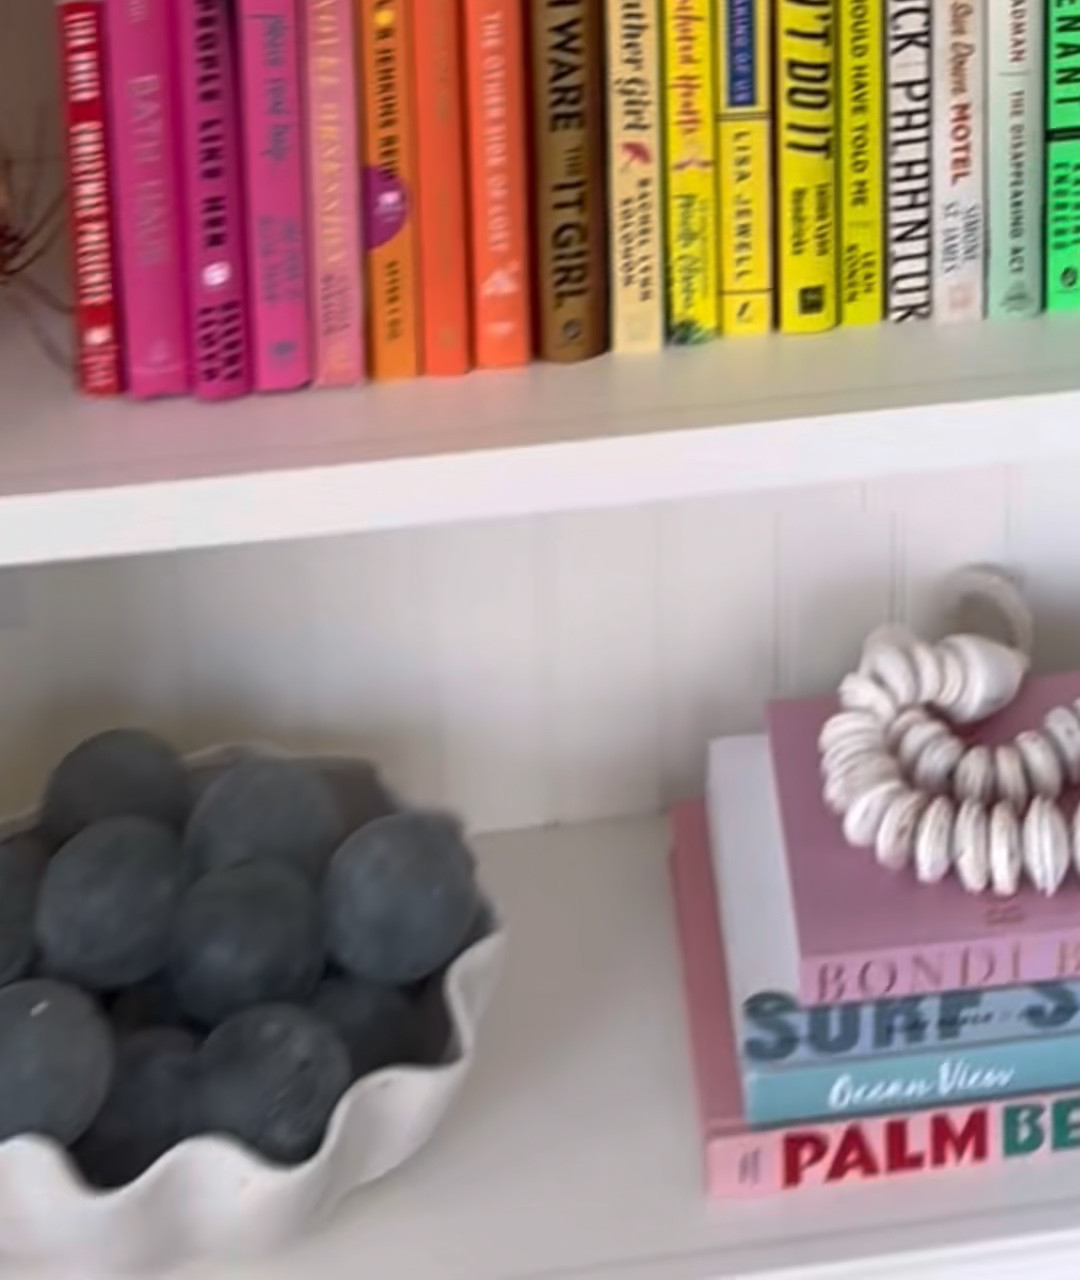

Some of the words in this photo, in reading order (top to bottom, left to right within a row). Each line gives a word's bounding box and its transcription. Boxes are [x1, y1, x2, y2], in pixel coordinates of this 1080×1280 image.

[545, 18, 587, 134] WARE
[733, 52, 751, 75] OF
[785, 59, 834, 111] DO
[848, 64, 871, 117] HAVE
[613, 77, 653, 133] Girl
[1008, 89, 1026, 118] THE
[732, 130, 753, 184] LISA
[784, 122, 834, 160] IT
[849, 123, 871, 174] TOLD
[948, 102, 972, 187] MOTEL
[551, 179, 588, 214] IT
[849, 179, 870, 208] ME
[888, 79, 933, 324] PALAHNIUK
[1007, 122, 1026, 239] DISAPPEARING
[732, 193, 754, 283] JEWELL
[1007, 246, 1025, 276] ACT
[815, 949, 1026, 1003] BONDI
[743, 991, 983, 1062] SURF
[827, 1070, 936, 1111] Ocean
[938, 1057, 1024, 1096] View
[781, 1109, 989, 1190] PALM
